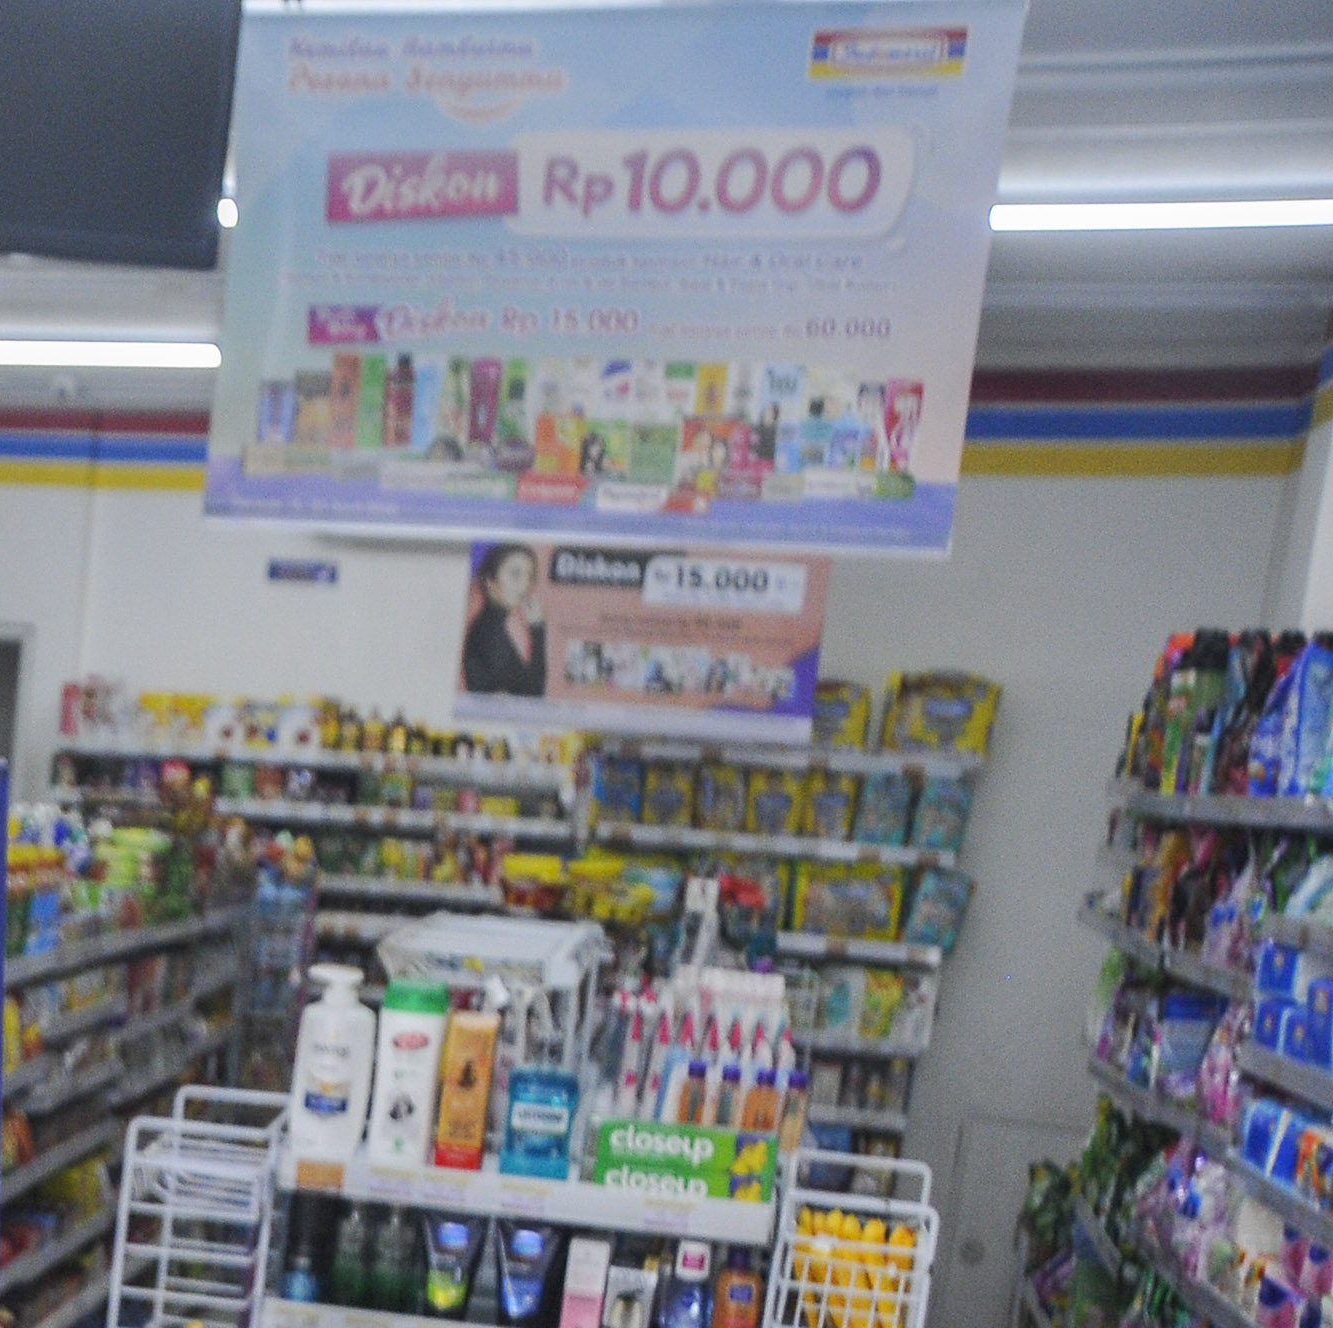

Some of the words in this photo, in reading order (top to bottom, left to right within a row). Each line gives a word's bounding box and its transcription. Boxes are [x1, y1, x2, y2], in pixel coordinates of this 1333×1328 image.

[342, 157, 501, 214] Diskon
[675, 562, 770, 594] 15.000
[609, 1124, 715, 1169] closeup
